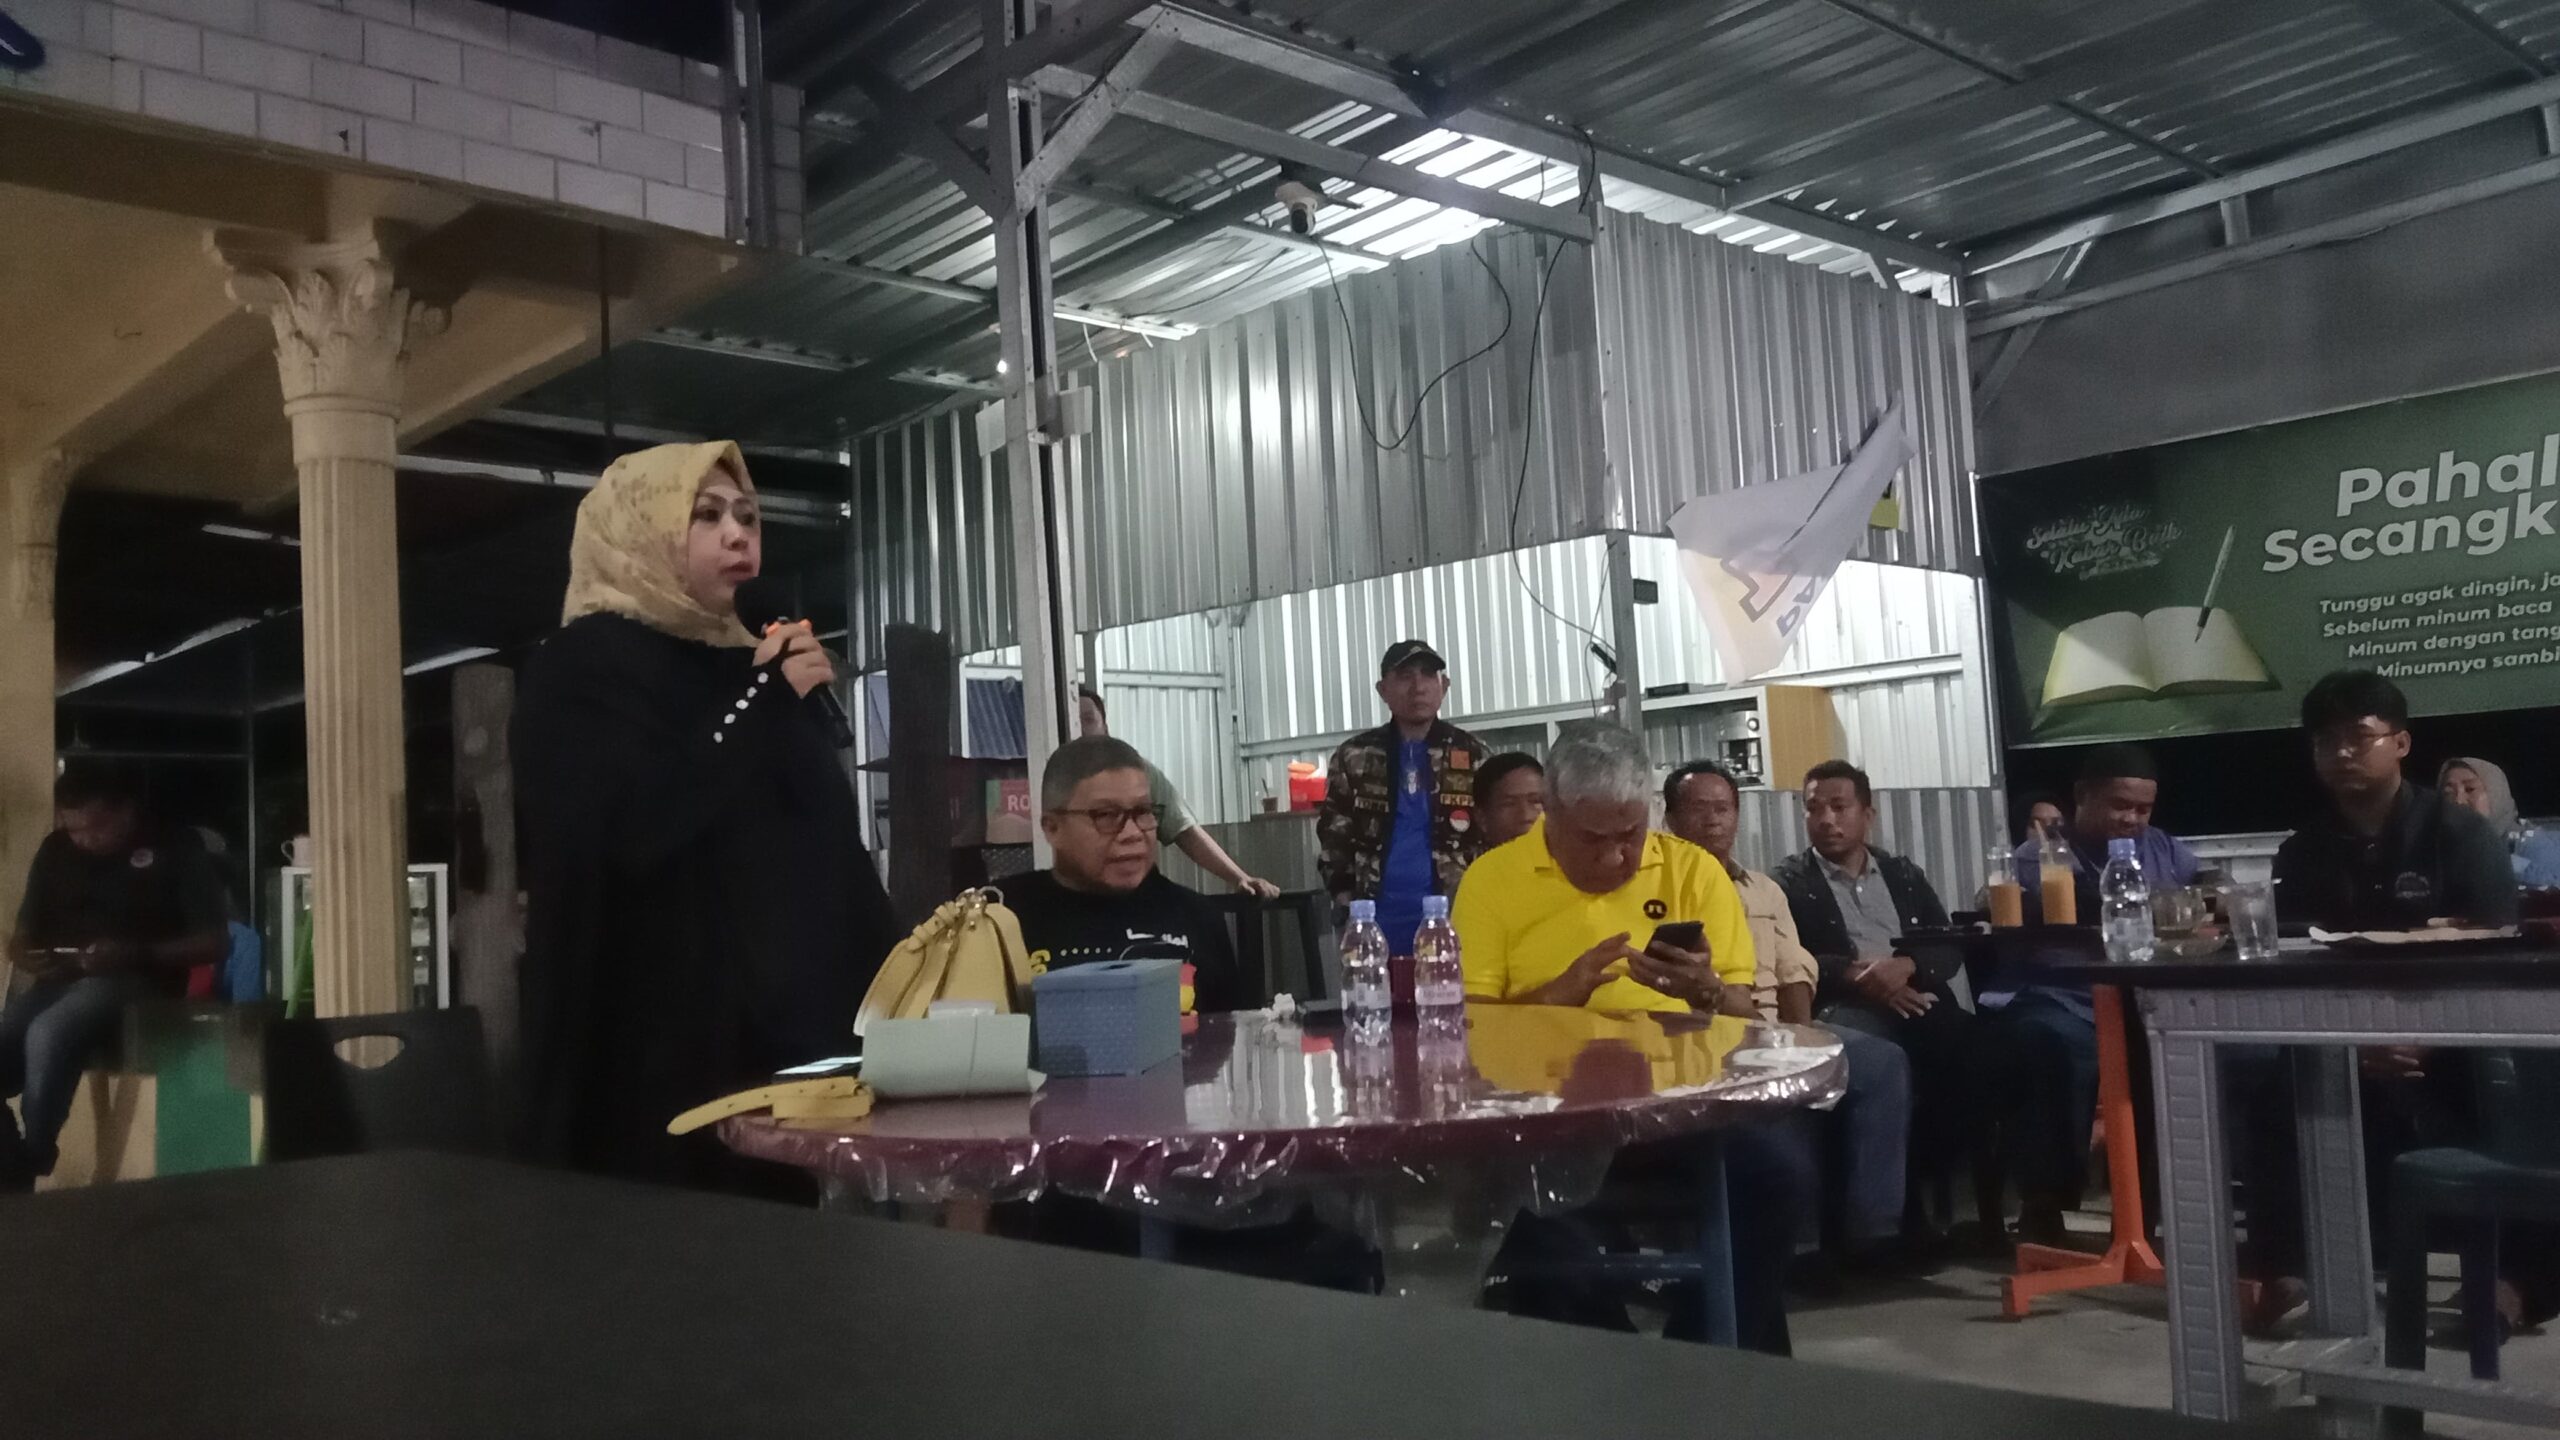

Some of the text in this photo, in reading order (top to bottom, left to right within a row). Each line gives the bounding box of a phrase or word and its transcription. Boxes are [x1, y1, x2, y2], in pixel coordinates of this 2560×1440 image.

[2337, 433, 2560, 517] Pahal
[2263, 492, 2560, 572] Secangk
[2320, 594, 2395, 613] Tunggu
[2401, 586, 2454, 605] agak
[2461, 576, 2536, 596] dingin,
[2323, 600, 2552, 637] Sebelum minum baca
[2349, 640, 2417, 658] Minum
[2423, 631, 2505, 649] dengan
[2377, 655, 2487, 678] Minumnya
